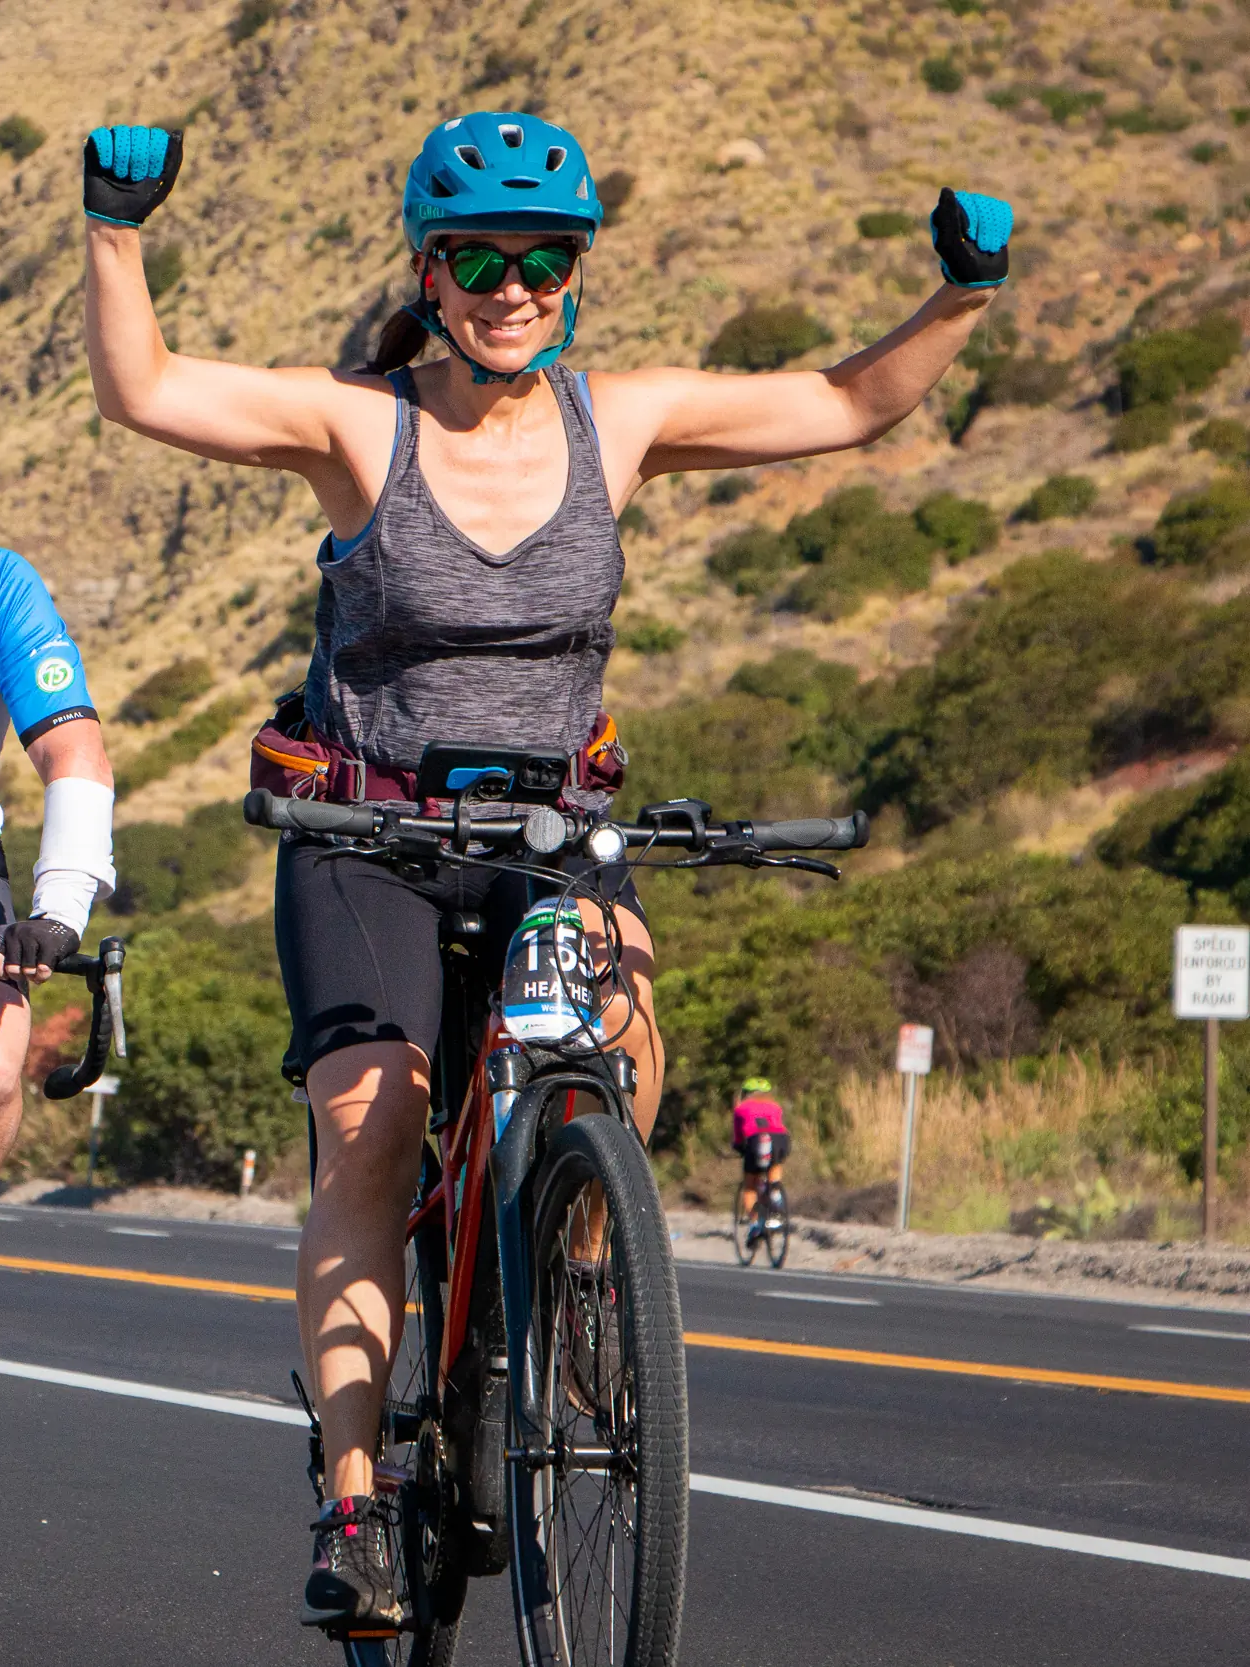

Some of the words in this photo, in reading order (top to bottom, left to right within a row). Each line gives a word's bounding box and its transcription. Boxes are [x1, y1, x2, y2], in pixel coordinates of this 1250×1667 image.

[52, 711, 84, 725] PRIMAL
[1194, 937, 1237, 952] SPEED
[1184, 956, 1247, 969] ENFORCED
[1205, 974, 1223, 988] BY
[1192, 991, 1236, 1006] RADAR
